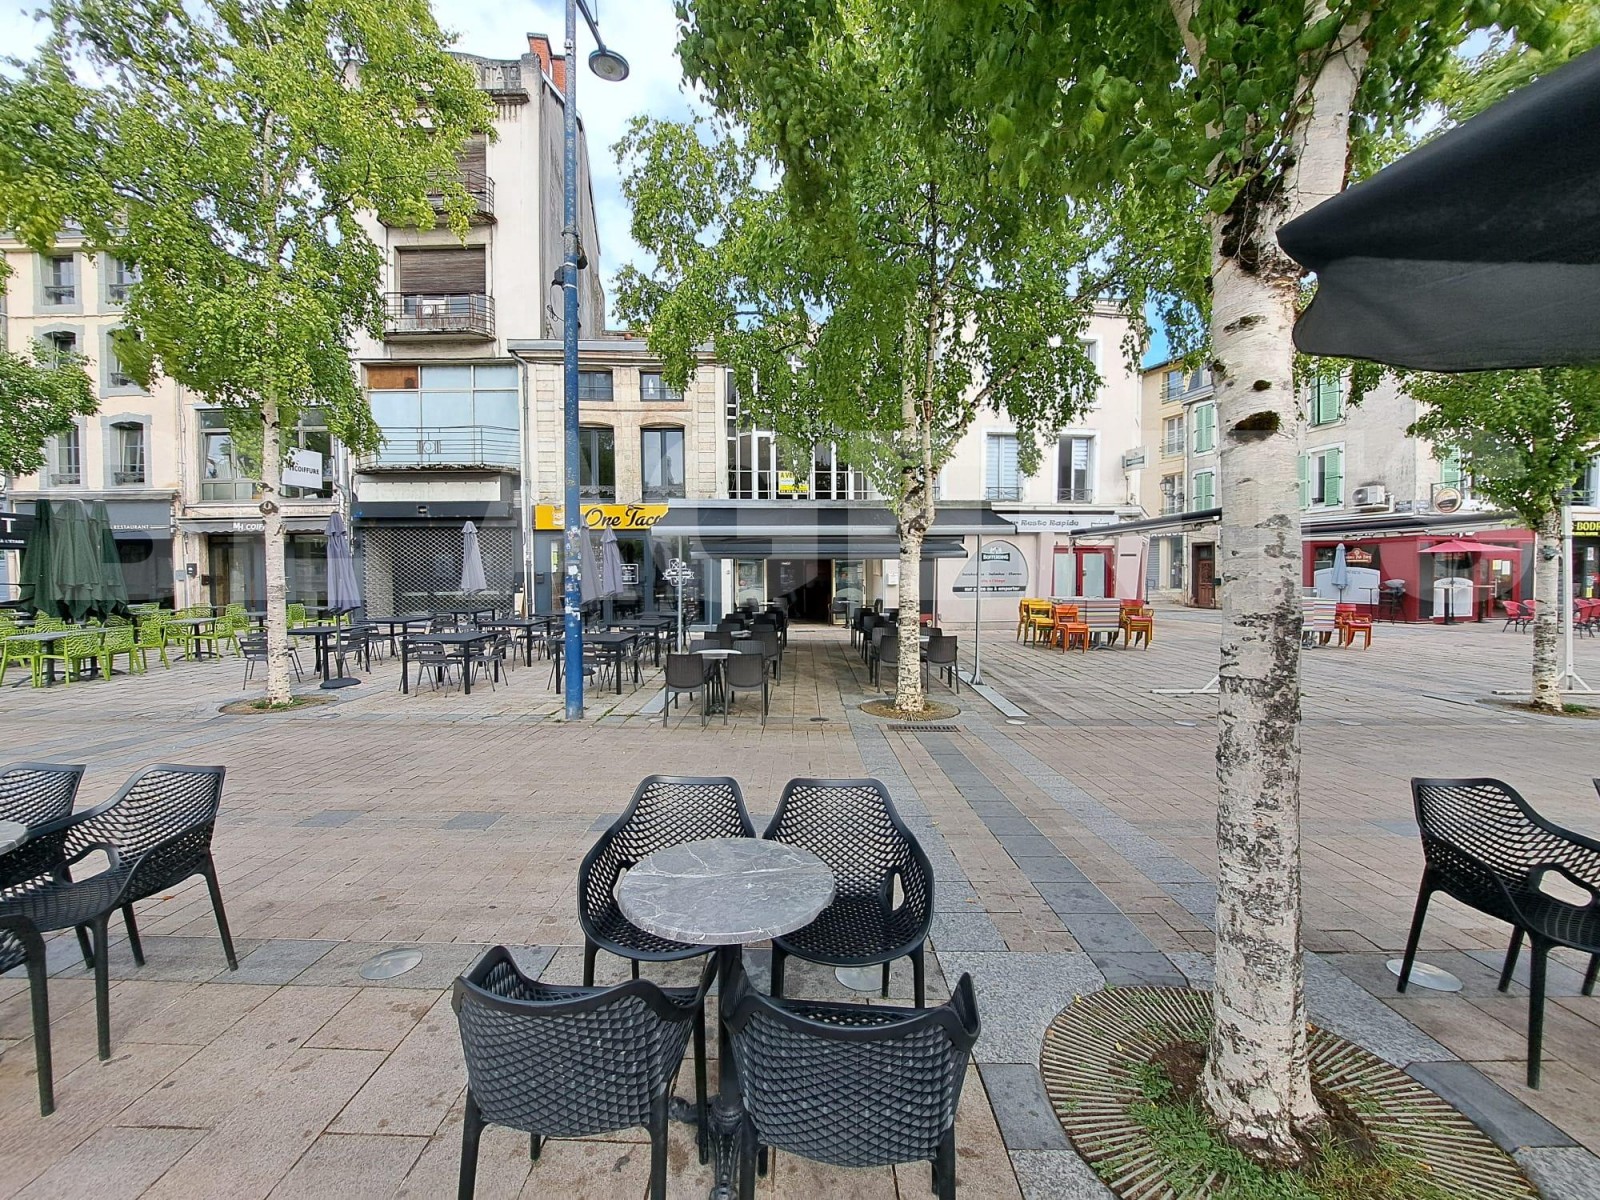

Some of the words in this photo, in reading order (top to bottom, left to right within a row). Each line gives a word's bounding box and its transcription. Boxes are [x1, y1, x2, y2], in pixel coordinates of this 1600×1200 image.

[295, 465, 320, 475] COIFFURE
[585, 507, 622, 527] One
[1021, 519, 1048, 527] Resto
[1049, 519, 1079, 528] Rapide
